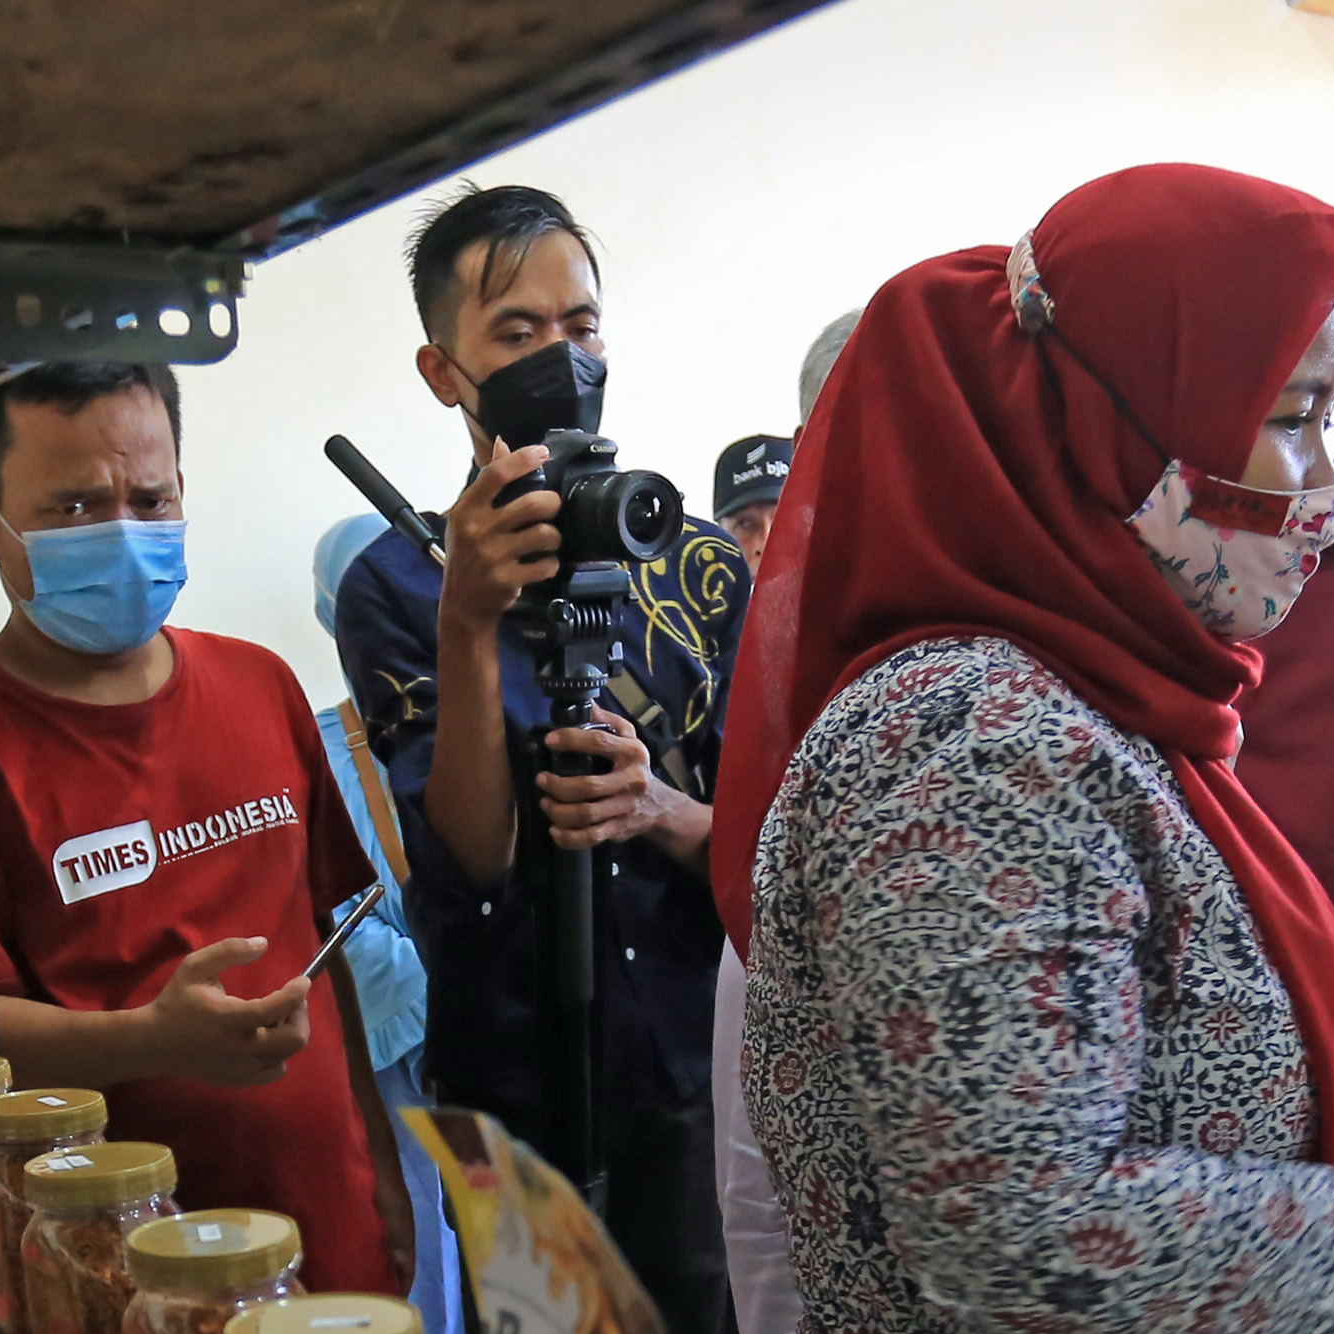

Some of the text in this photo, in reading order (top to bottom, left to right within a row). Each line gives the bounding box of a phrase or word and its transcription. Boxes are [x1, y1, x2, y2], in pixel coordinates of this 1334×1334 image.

[732, 460, 790, 485] bank bjb
[60, 840, 149, 884] TIMES
[158, 795, 298, 857] INDONESIA
